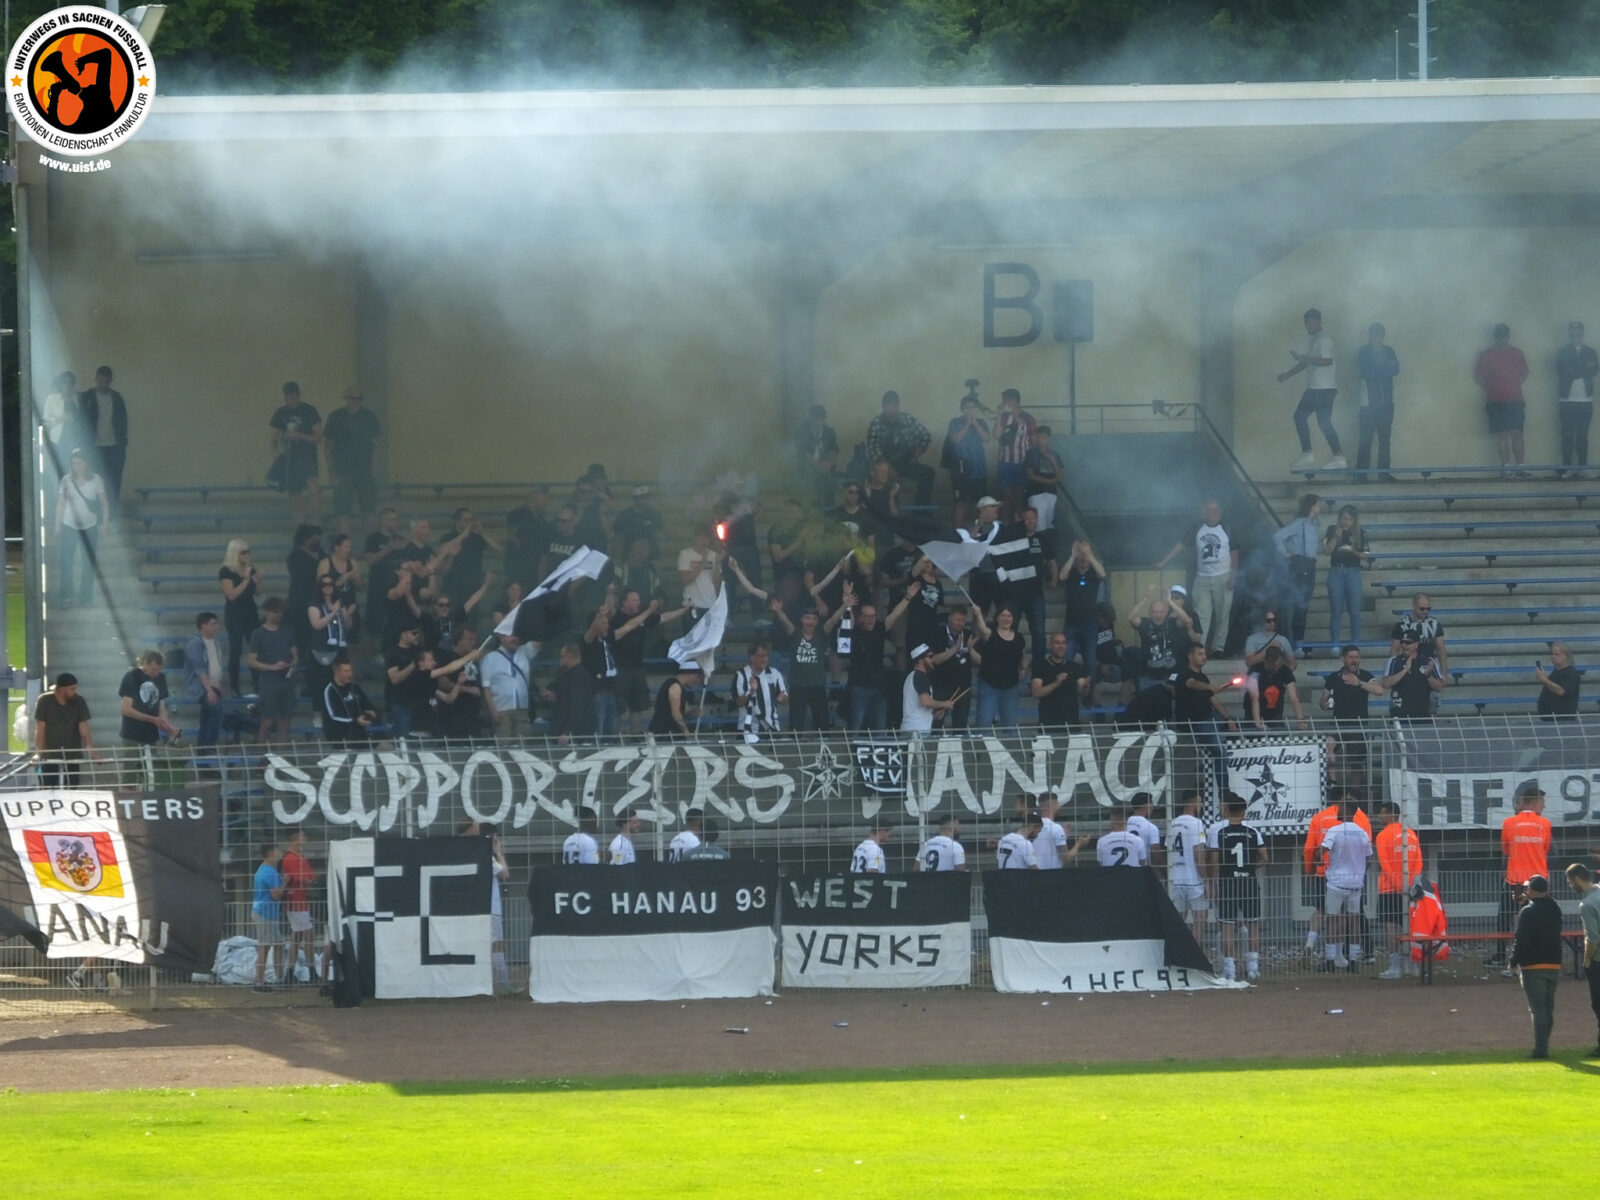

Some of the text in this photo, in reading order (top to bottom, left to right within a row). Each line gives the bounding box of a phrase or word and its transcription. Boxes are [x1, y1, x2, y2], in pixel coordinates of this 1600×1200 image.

[983, 262, 1043, 348] B
[856, 746, 903, 766] FCK
[860, 768, 902, 785] HFV
[264, 746, 796, 832] SUPPORTERS
[3, 797, 204, 820] UPPORTERS
[1172, 831, 1185, 857] 4
[1230, 841, 1244, 868] 1
[925, 849, 940, 872] 9
[999, 847, 1014, 869] 7
[1110, 846, 1129, 867] 2
[553, 886, 766, 915] FC HANAU 93
[789, 877, 908, 909] WEST
[795, 930, 942, 975] YORKS
[1061, 974, 1073, 990] 1
[1088, 969, 1145, 990] HFC
